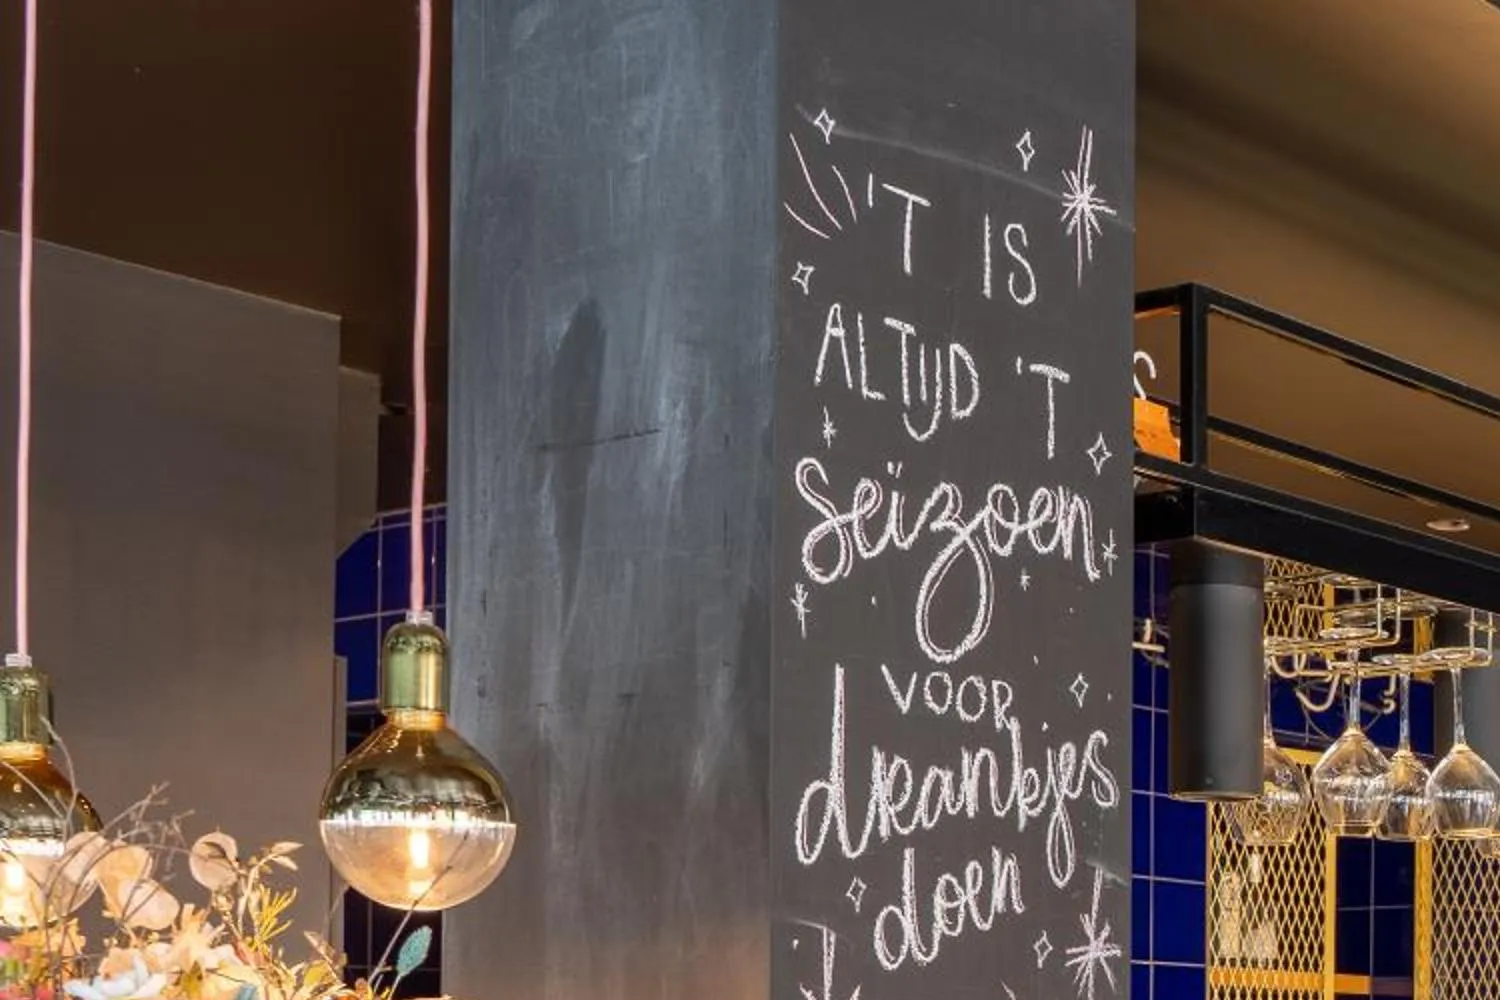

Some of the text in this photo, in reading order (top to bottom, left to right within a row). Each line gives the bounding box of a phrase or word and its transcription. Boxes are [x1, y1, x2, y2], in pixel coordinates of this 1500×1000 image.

[981, 212, 1037, 305] IS
[794, 663, 1120, 889] drankjes
[873, 845, 1026, 971] doen
